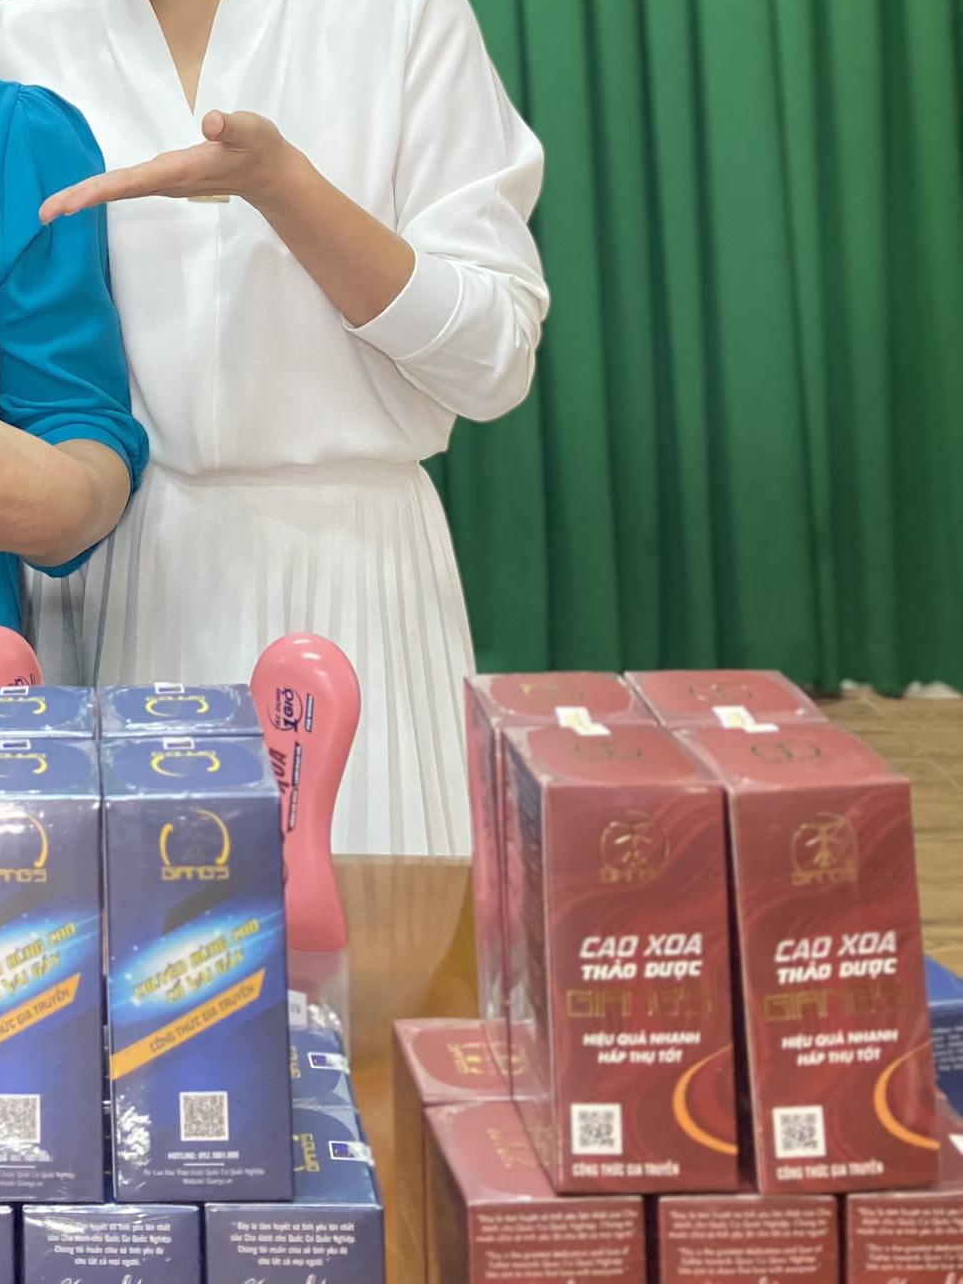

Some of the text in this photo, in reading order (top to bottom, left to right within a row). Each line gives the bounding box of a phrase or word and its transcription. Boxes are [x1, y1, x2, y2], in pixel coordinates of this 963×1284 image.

[579, 932, 703, 959] CAO XOA
[774, 930, 897, 963] CAO XOA
[581, 958, 638, 981] THẢO
[776, 961, 832, 985] THẢO
[649, 1031, 701, 1045] NHANH
[847, 1029, 899, 1045] NHANH
